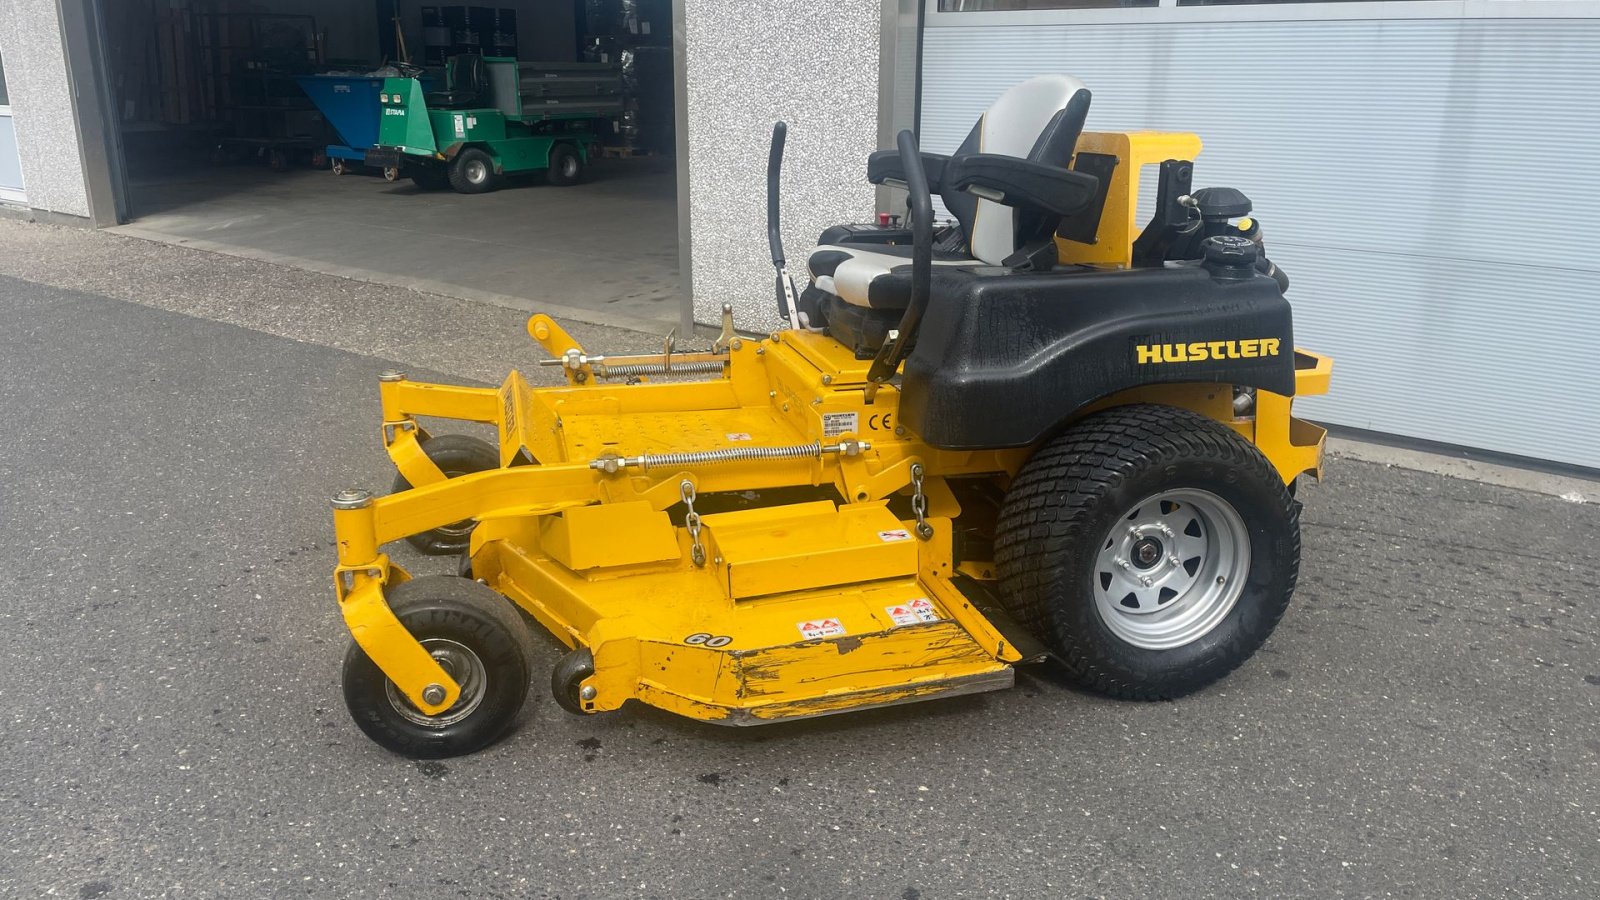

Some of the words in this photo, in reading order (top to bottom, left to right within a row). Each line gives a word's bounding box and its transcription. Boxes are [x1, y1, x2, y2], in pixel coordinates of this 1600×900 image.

[1136, 338, 1280, 364] HUSTLER
[869, 413, 892, 431] CE
[683, 632, 734, 648] 60
